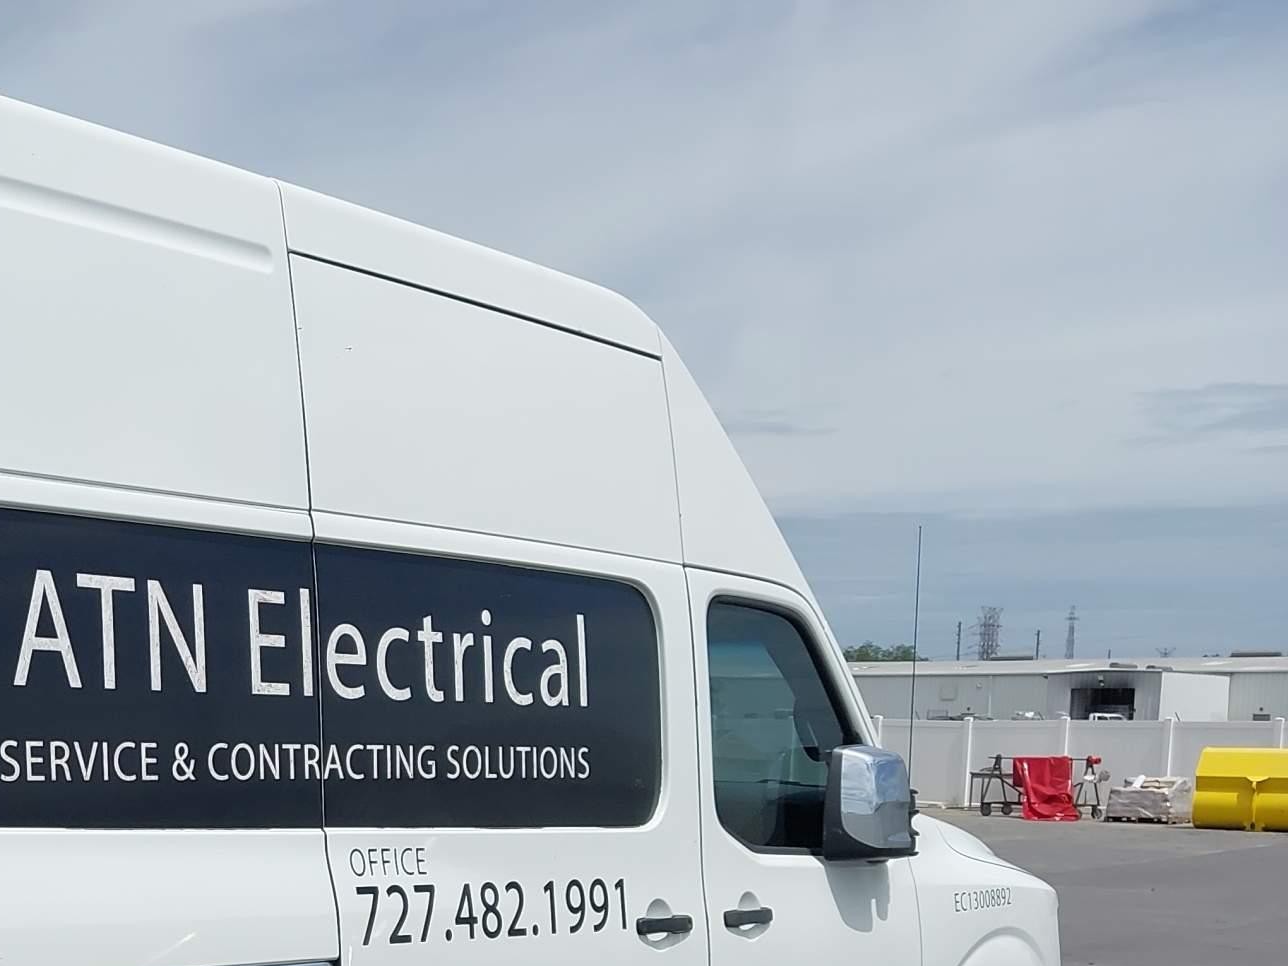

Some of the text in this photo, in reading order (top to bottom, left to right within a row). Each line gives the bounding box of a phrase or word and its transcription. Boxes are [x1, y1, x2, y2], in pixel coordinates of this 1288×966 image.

[13, 568, 588, 708] ATN Electrical
[0, 740, 590, 783] SERVICE & CONTRACTING SOLUTIONS
[349, 847, 428, 877] OFFICE
[355, 878, 630, 946] 727.482.1991
[954, 887, 1012, 913] EC13008892
